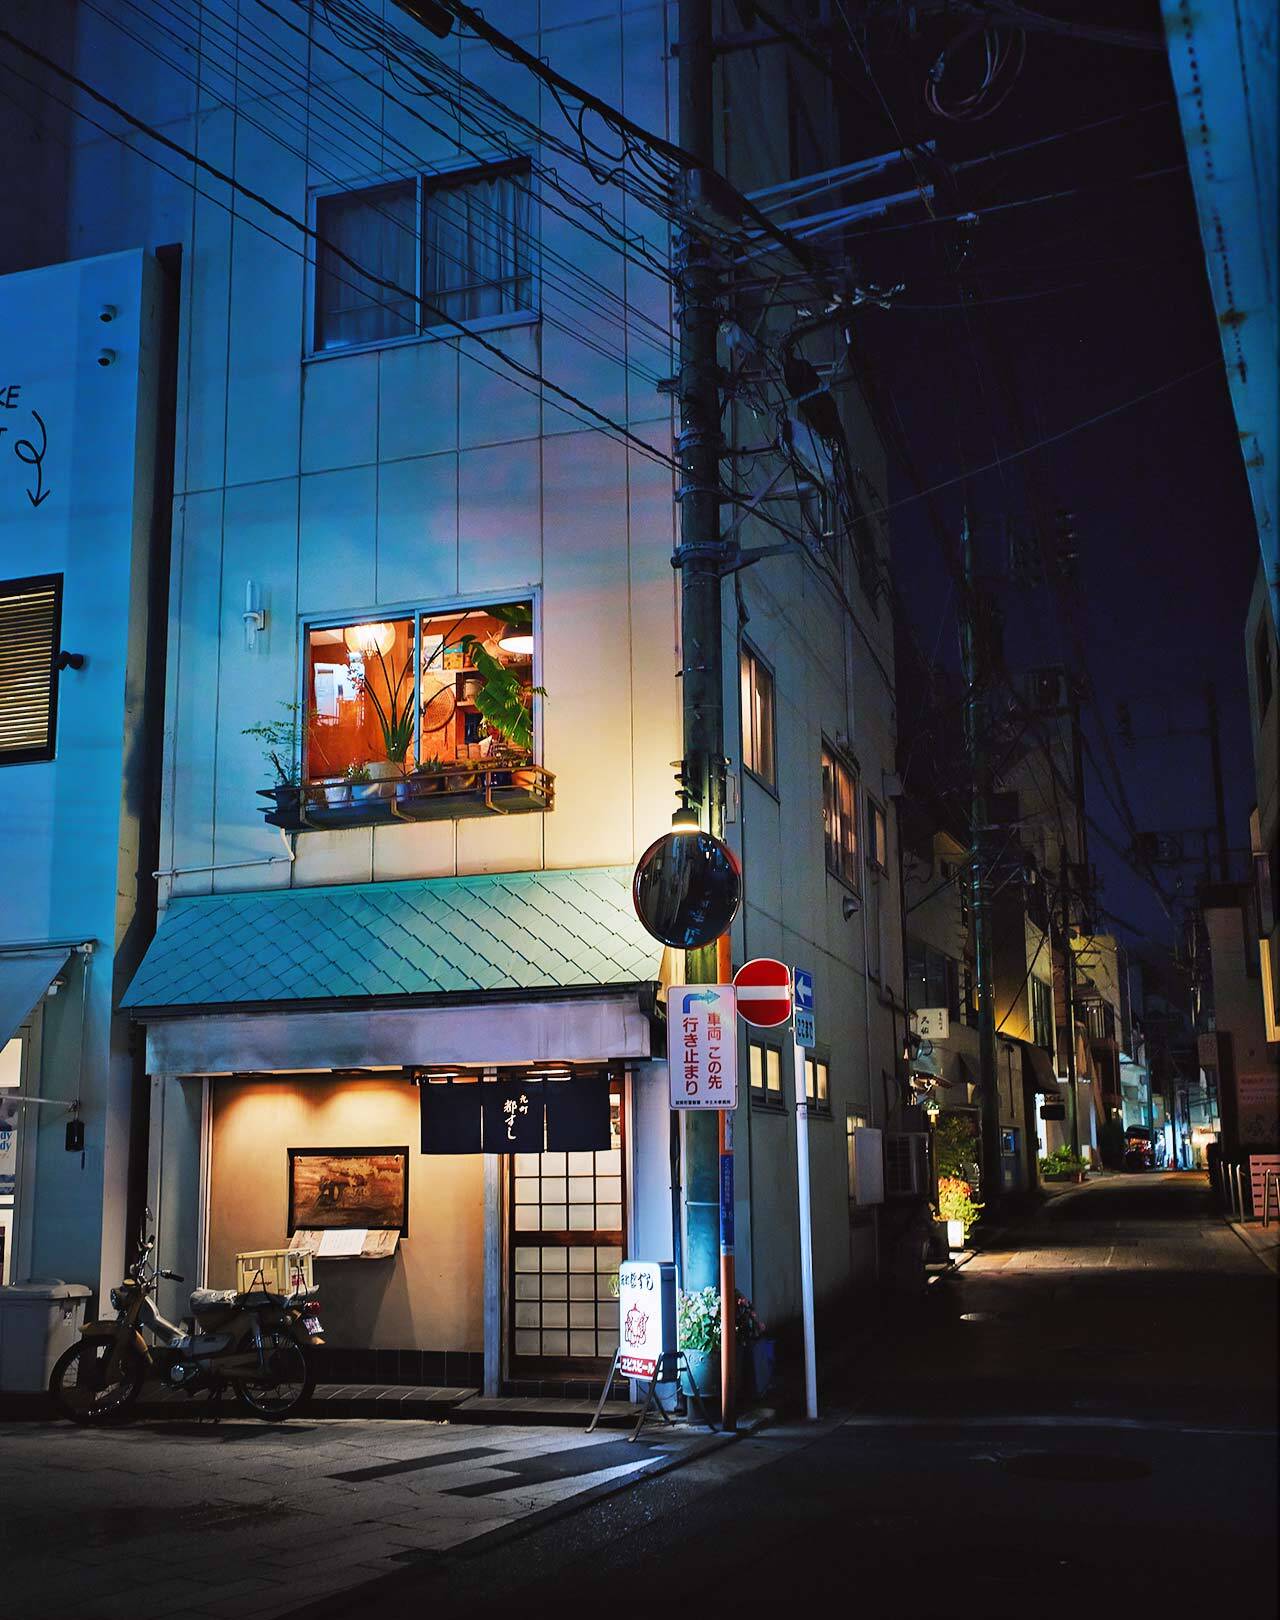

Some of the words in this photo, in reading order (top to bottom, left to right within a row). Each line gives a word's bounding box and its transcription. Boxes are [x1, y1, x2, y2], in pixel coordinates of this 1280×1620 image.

[707, 1012, 722, 1041] 車両
[797, 1018, 813, 1040] ここまで
[682, 1017, 699, 1096] 行き止まり
[708, 1046, 722, 1089] この先
